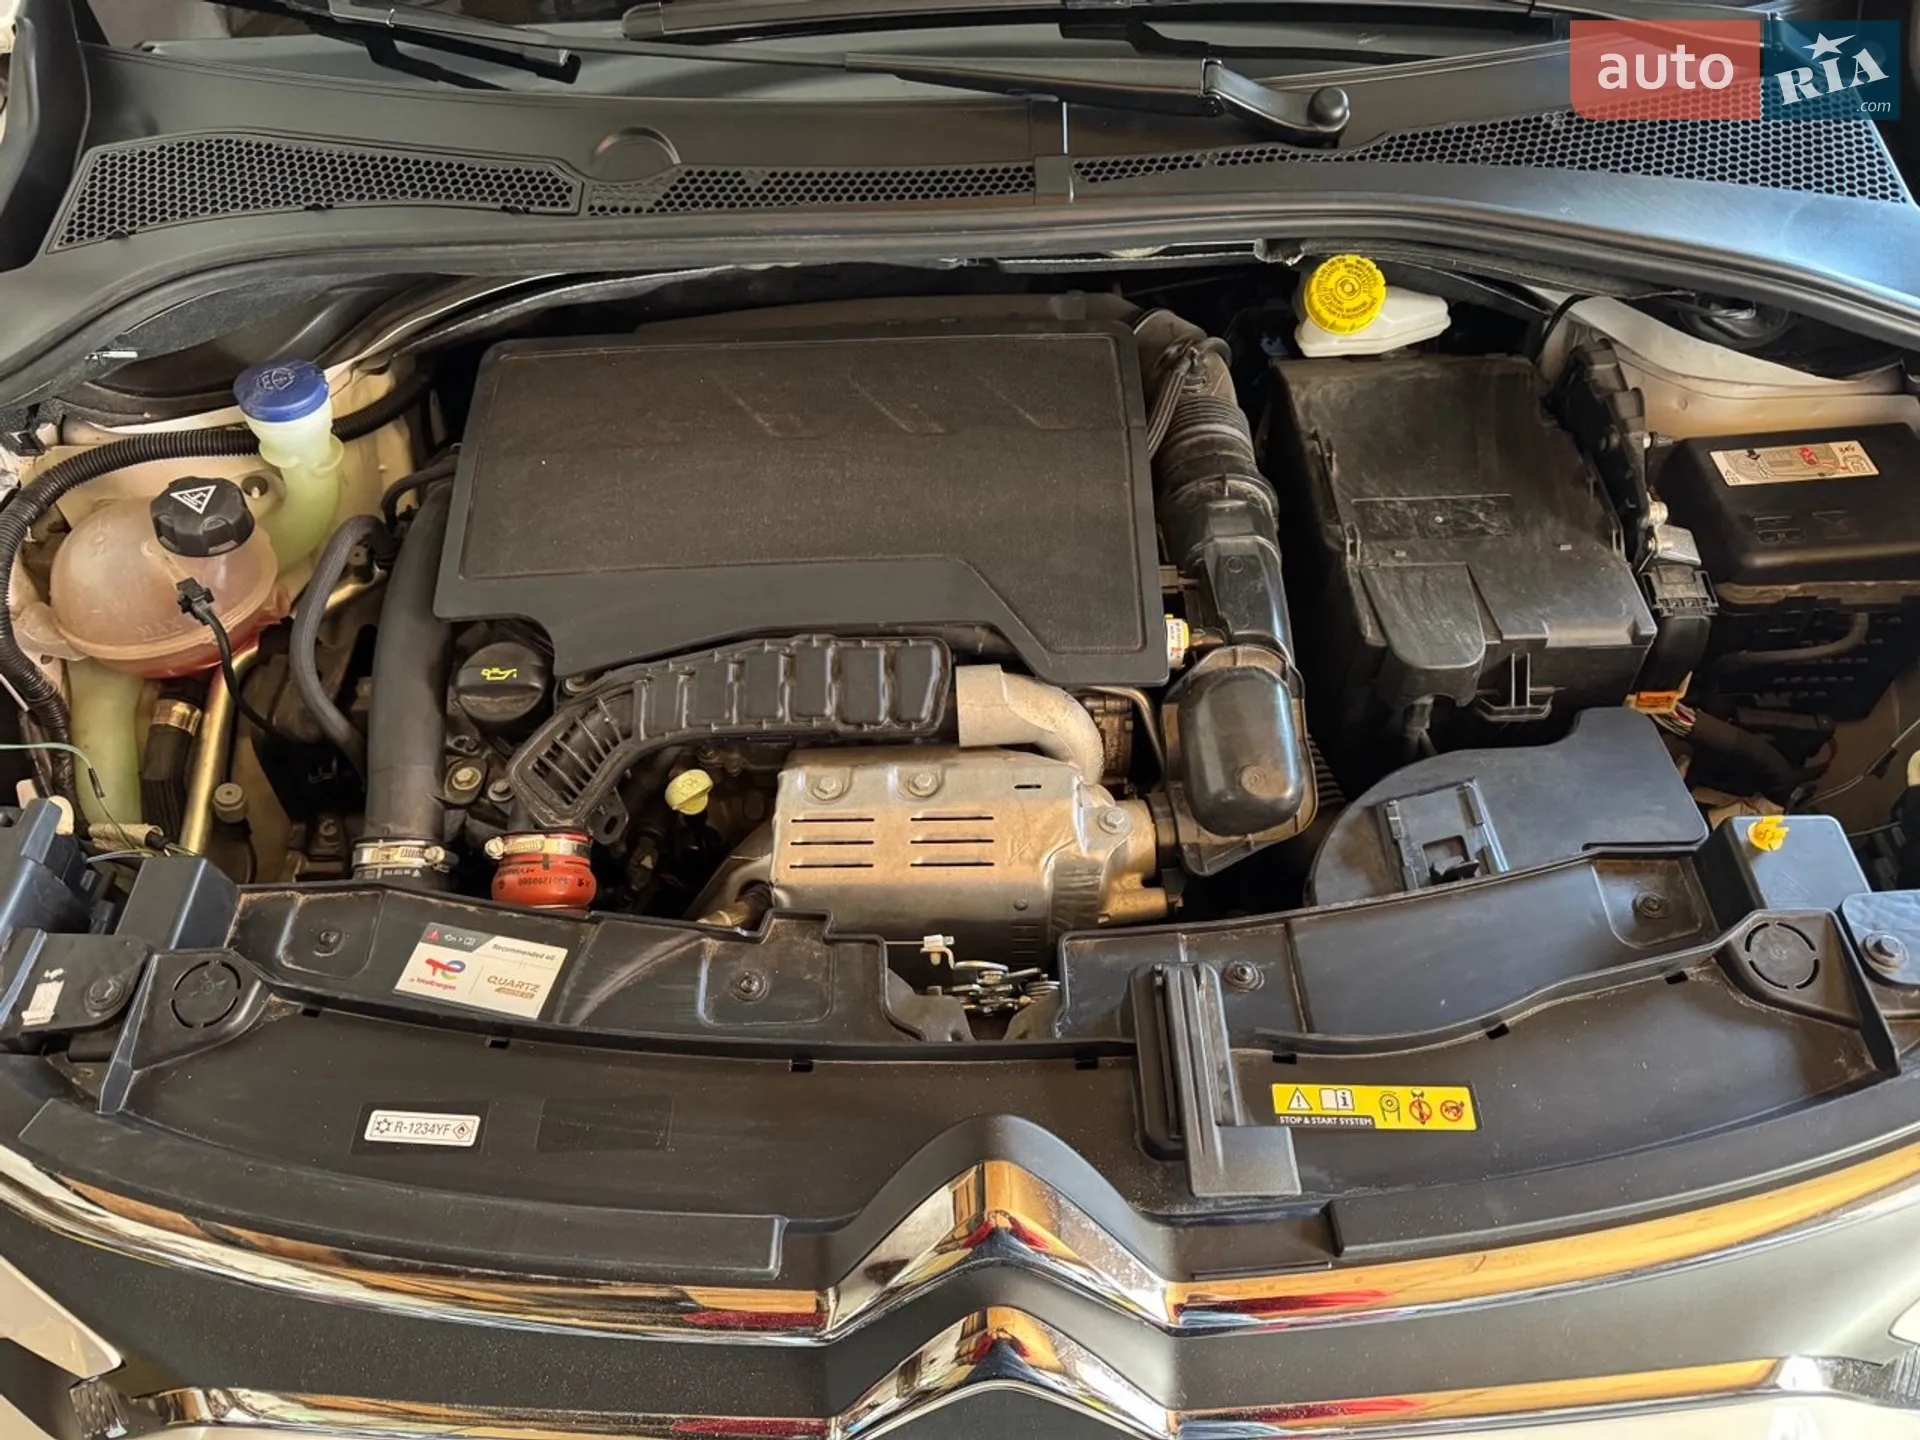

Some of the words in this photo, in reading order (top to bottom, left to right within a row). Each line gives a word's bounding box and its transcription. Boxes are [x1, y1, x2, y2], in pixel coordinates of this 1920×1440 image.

[487, 975, 541, 993] QUARTZ
[1279, 1115, 1303, 1125] STOP
[1303, 1116, 1311, 1125] &
[1311, 1116, 1338, 1125] START
[1339, 1117, 1373, 1126] SYSTEM
[394, 1121, 451, 1136] R-1234YF
